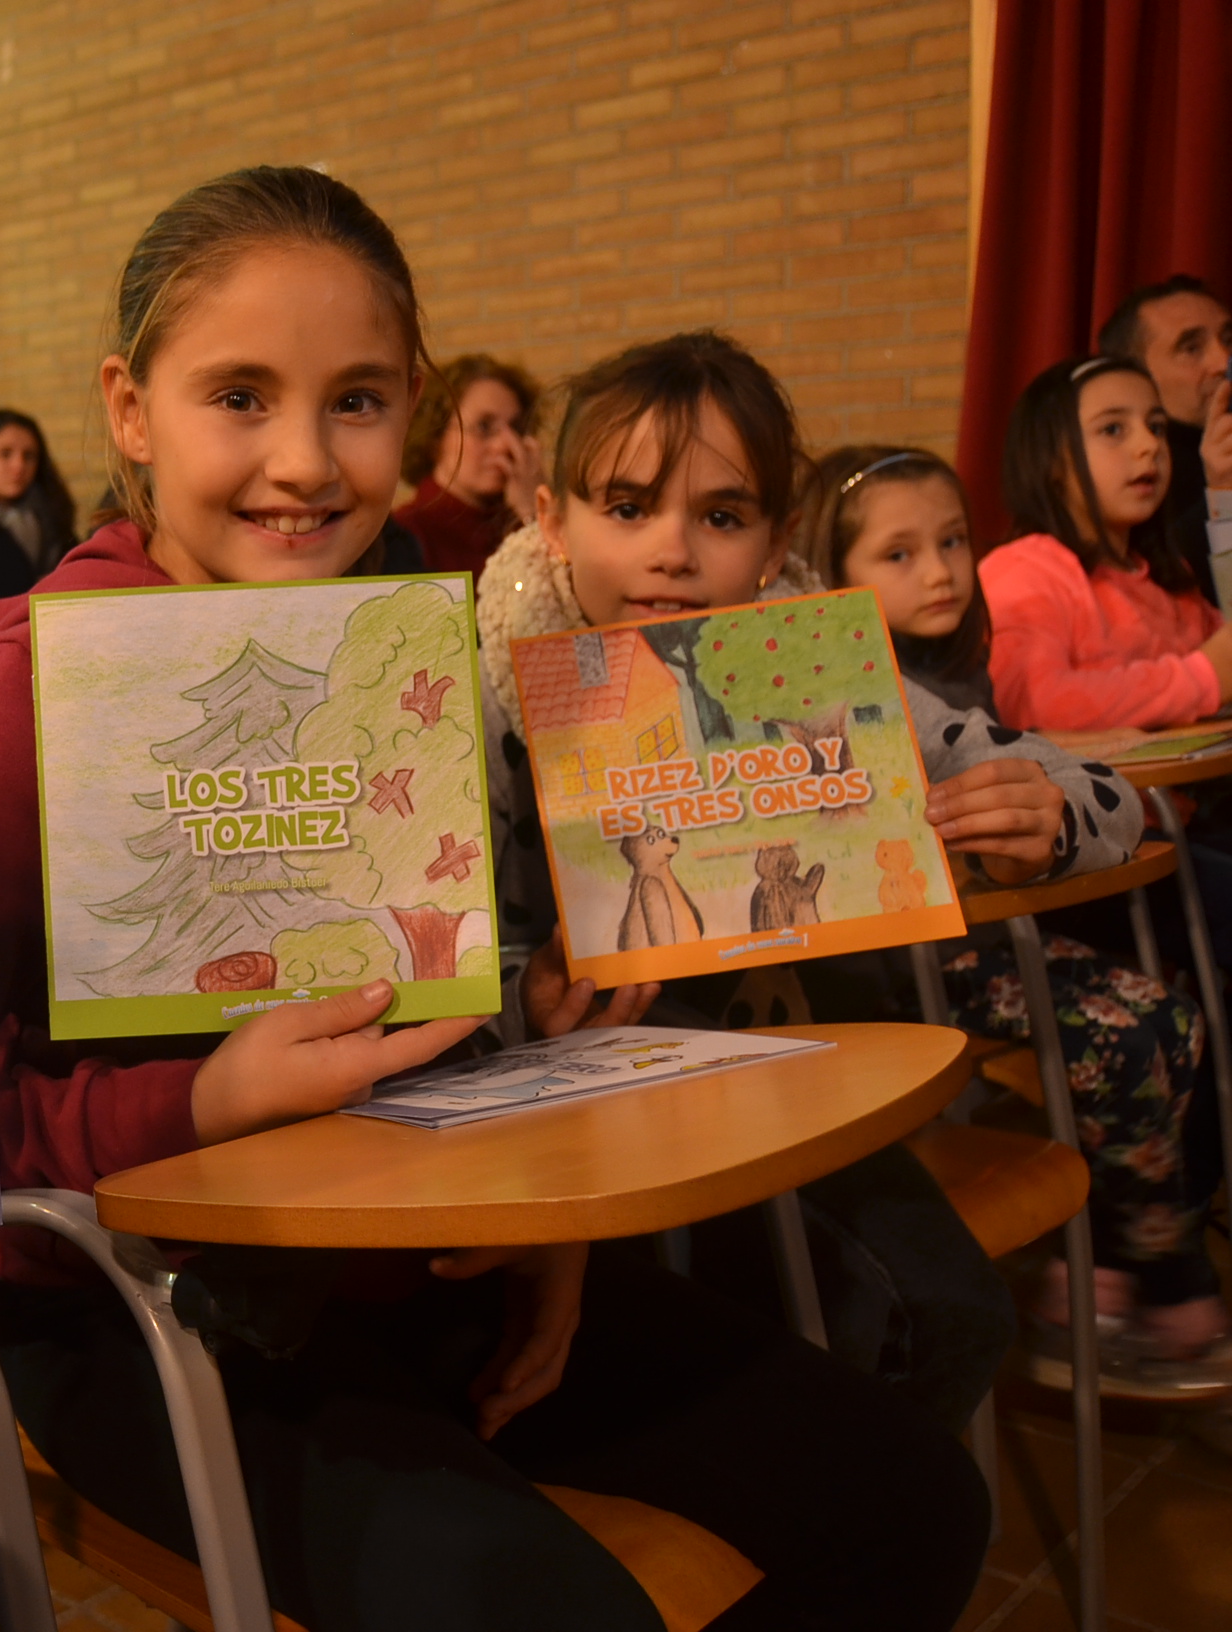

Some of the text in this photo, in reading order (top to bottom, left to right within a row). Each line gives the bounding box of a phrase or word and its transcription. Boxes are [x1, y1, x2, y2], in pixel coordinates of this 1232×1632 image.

[165, 764, 358, 809] LOS TRES
[606, 739, 841, 800] RIZEZ D'ORO Y
[182, 809, 347, 853] TOZINEZ
[598, 771, 871, 838] ES TRES ONSOS
